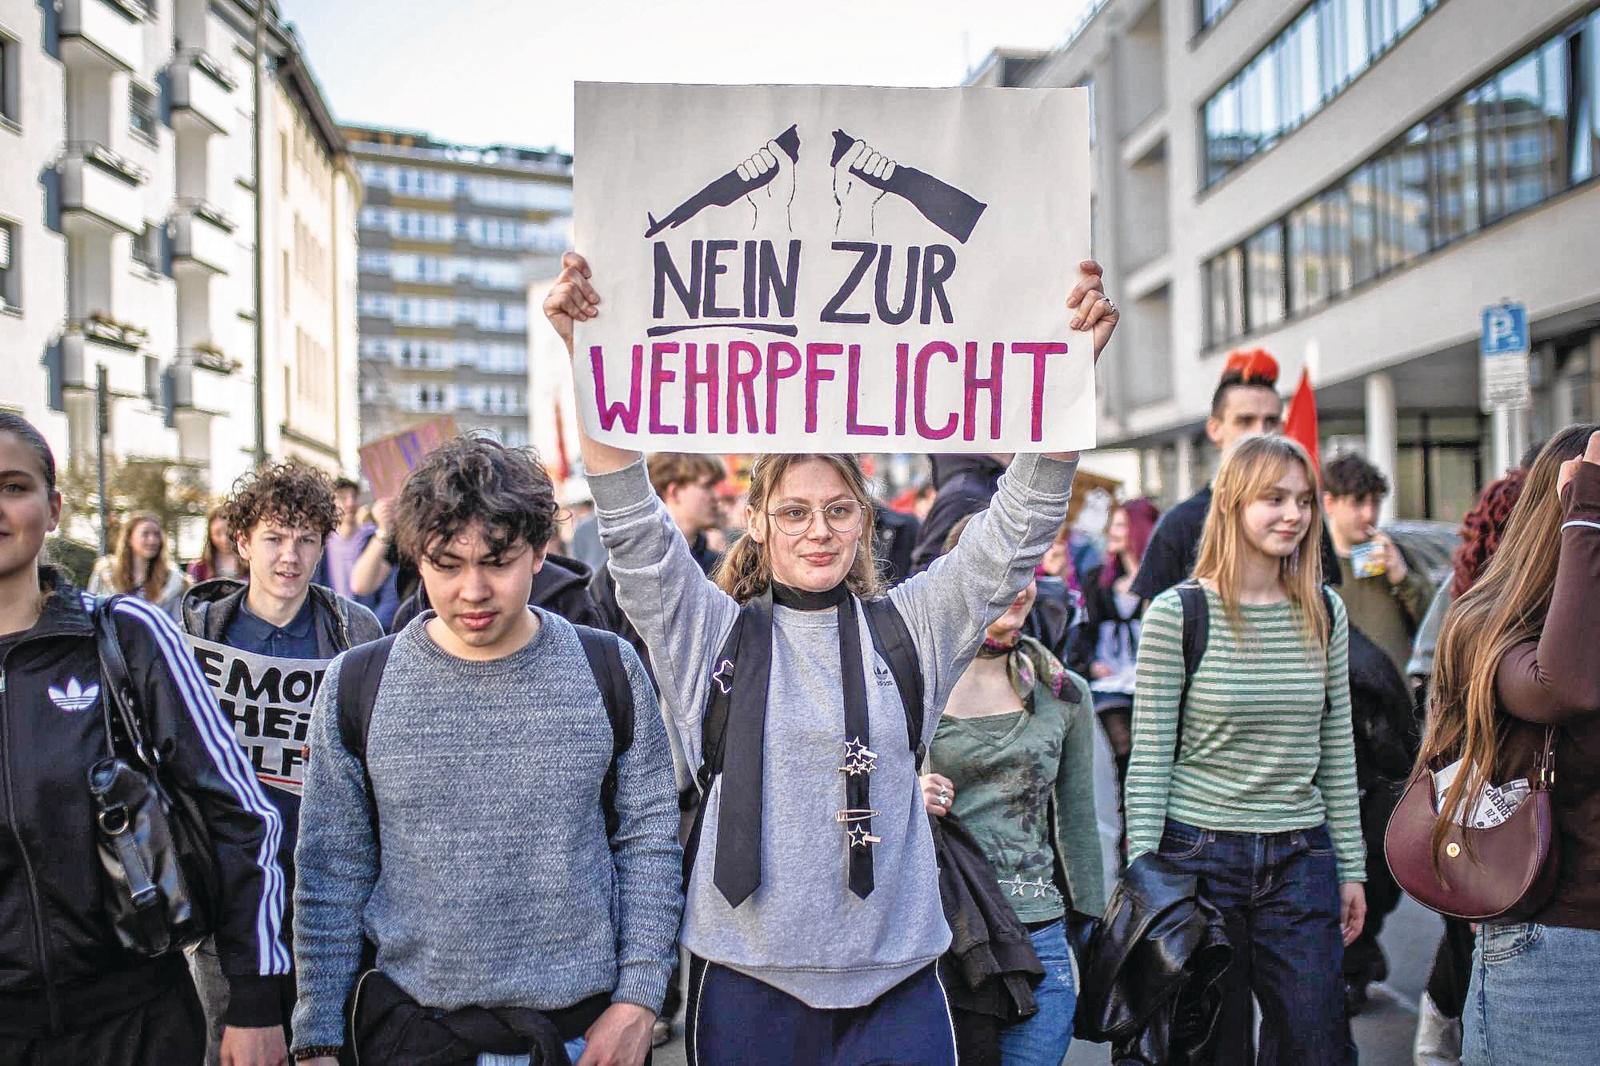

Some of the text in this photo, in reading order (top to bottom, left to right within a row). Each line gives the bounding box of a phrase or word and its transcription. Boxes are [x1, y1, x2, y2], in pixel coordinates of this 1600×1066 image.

[653, 239, 957, 326] NEIN ZUR
[1488, 309, 1515, 349] P
[589, 341, 1068, 443] WEHRPFLICHT
